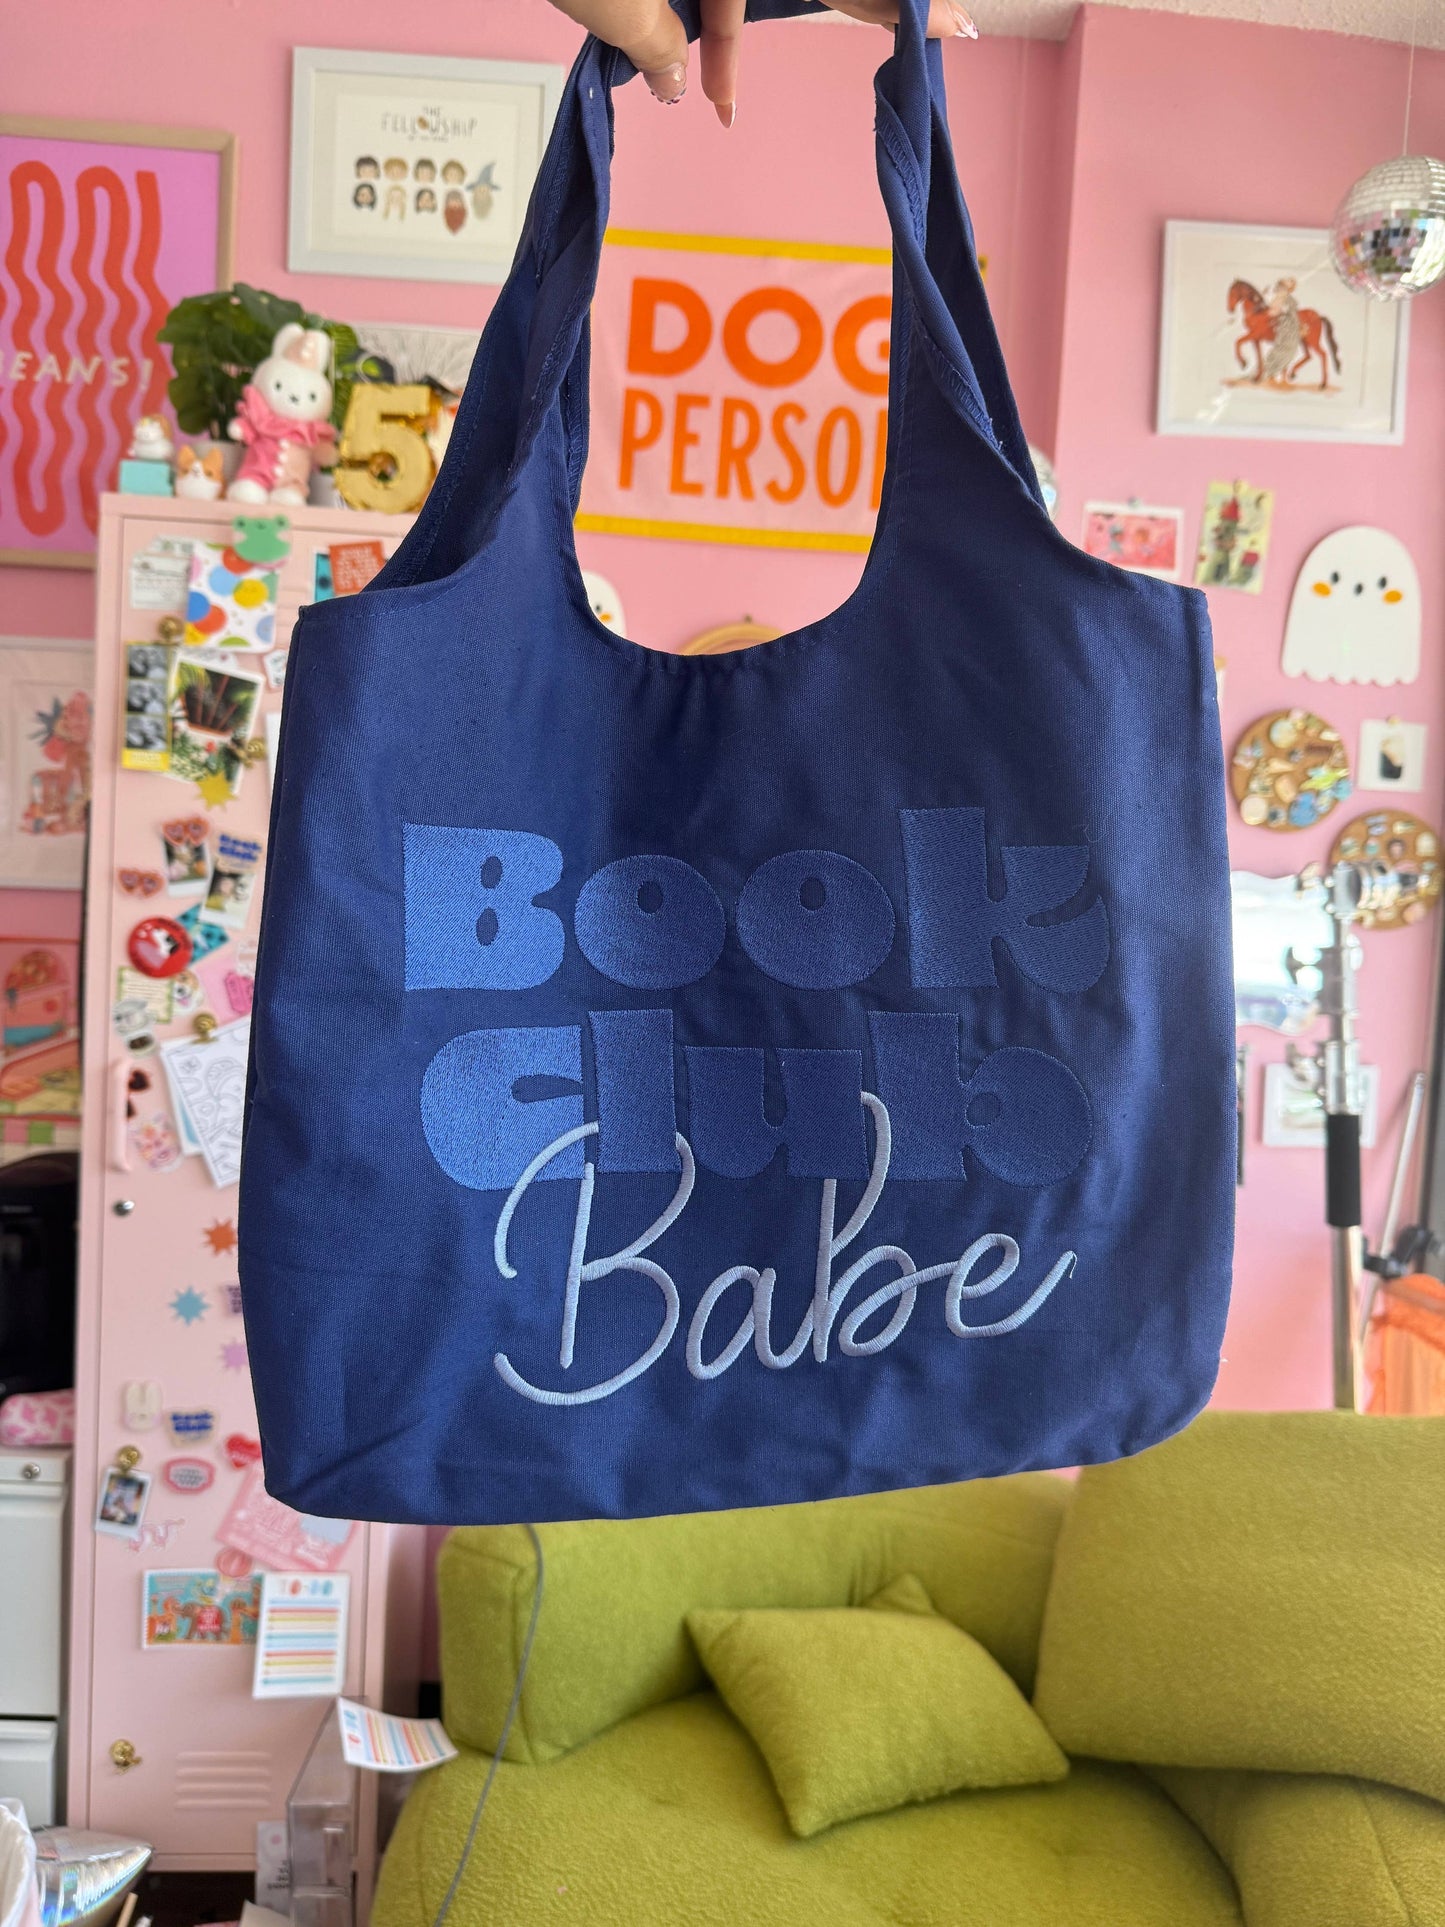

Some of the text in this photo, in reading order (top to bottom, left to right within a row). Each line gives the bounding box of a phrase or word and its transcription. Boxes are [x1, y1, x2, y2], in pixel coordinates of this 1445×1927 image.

[0, 351, 154, 394] EANS!
[626, 276, 892, 399] DOG
[401, 806, 1111, 994] Book
[420, 1008, 1094, 1190] Club
[495, 1091, 1077, 1406] Babe
